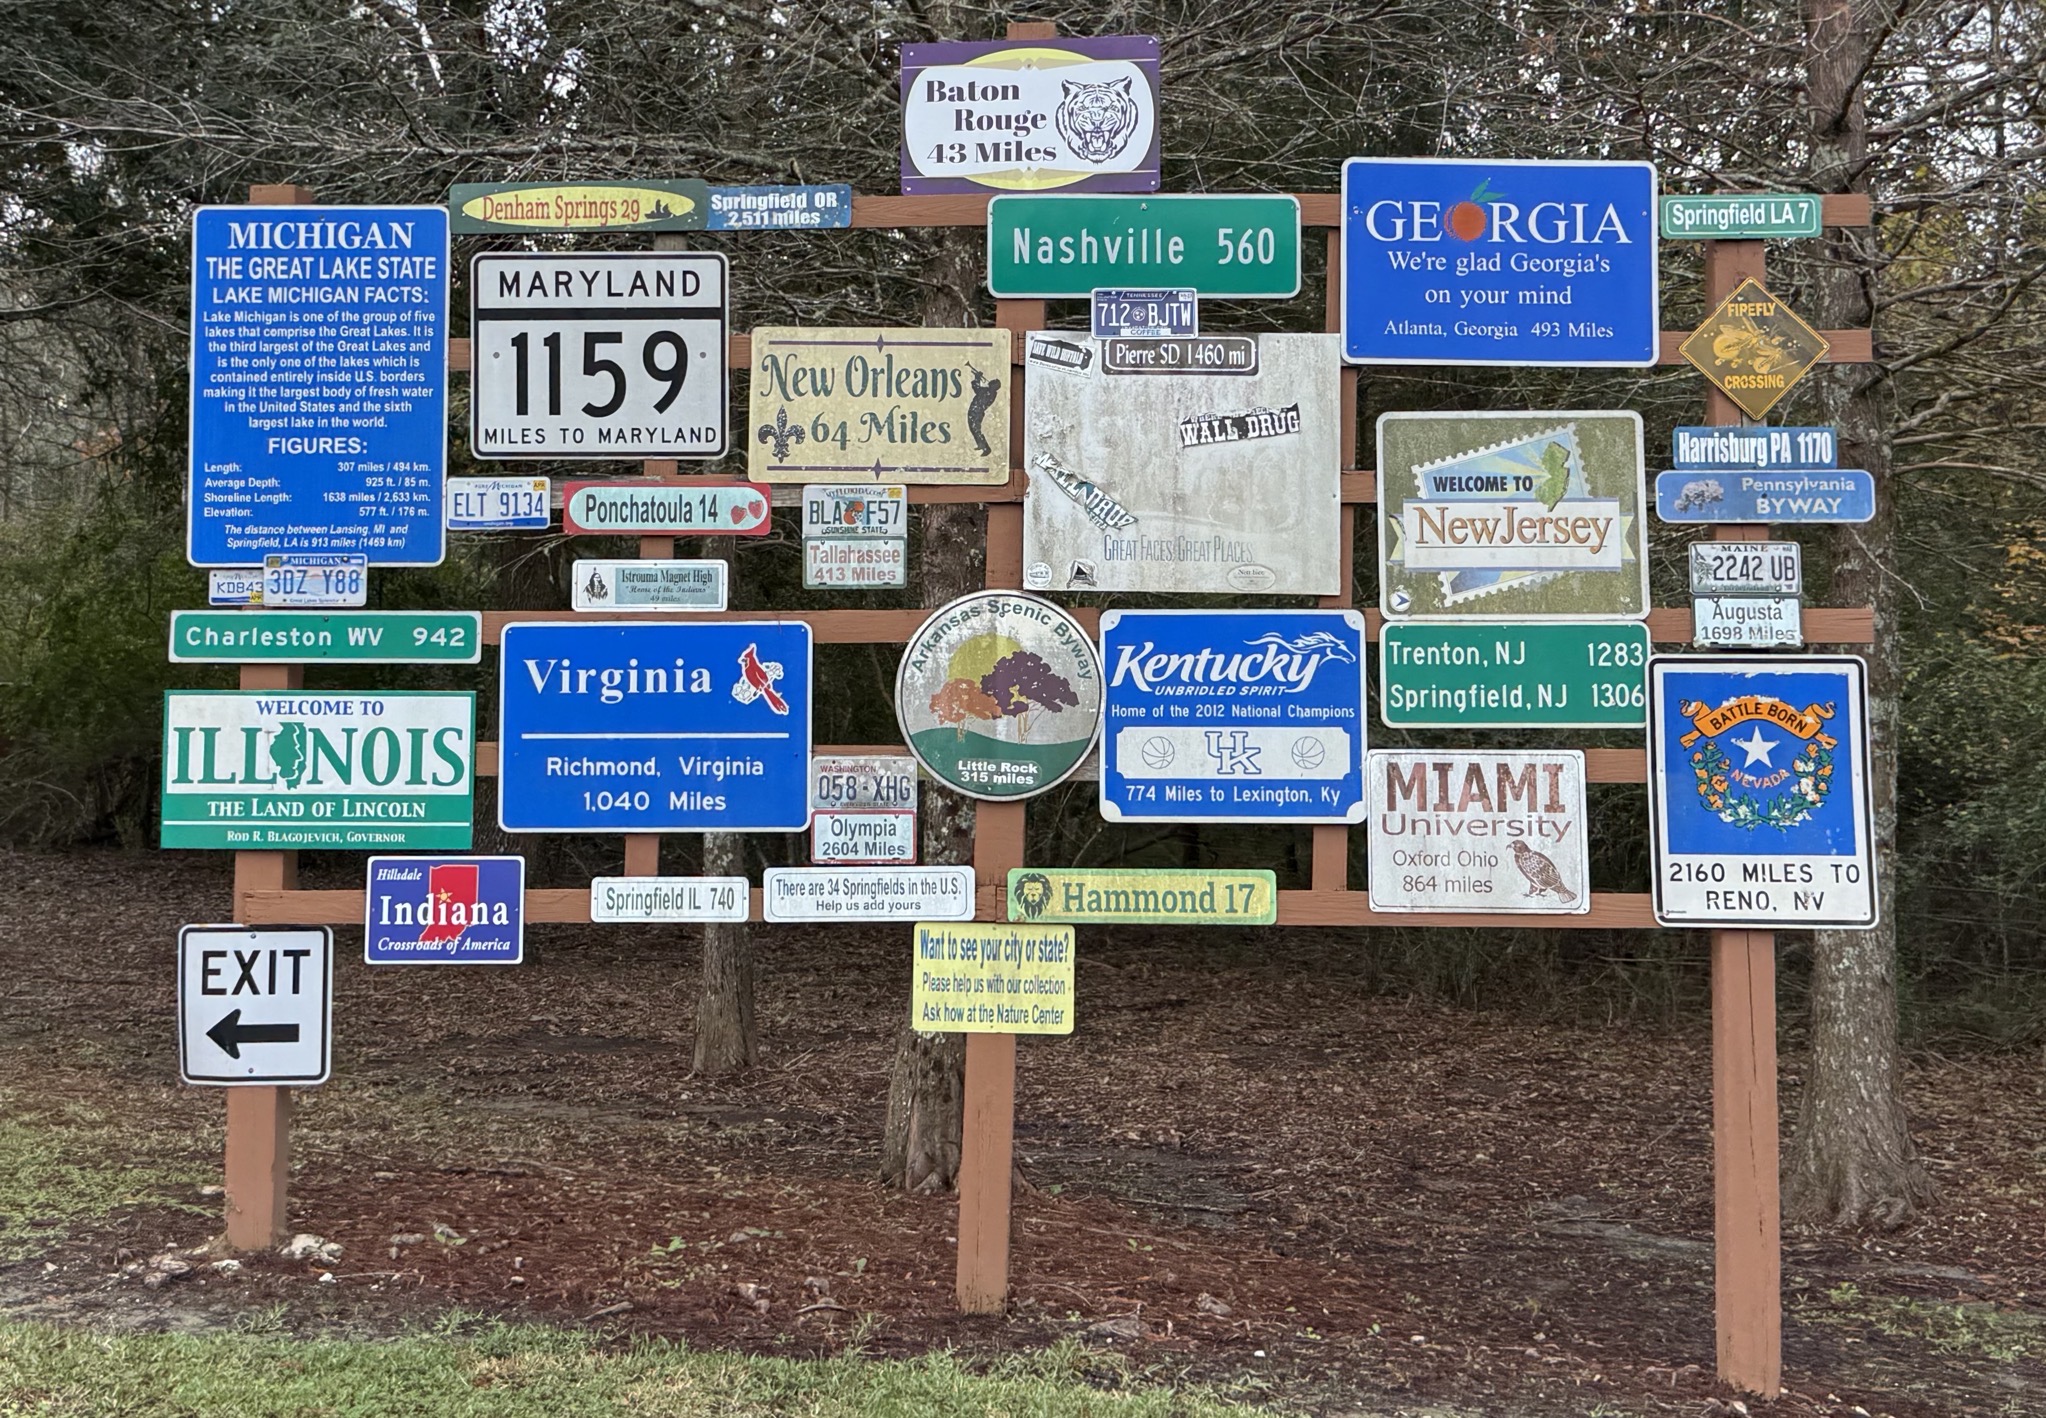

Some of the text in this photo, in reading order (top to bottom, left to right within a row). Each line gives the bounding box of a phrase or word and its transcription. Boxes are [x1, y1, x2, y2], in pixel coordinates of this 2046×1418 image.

[926, 80, 1019, 102] Baton
[955, 109, 1046, 137] Rouge
[928, 141, 1056, 163] 43 Miles
[482, 196, 640, 226] Denham Springs 29
[711, 192, 837, 211] Springfield OR
[772, 210, 820, 225] miles
[1672, 202, 1809, 229] Springfield LA 7
[228, 222, 415, 250] MICHIGAN
[1013, 228, 1275, 265] Nashville 560
[206, 257, 436, 280] THE GREAT LAKE STATE
[1387, 251, 1610, 277] We're glad Georgia's
[500, 270, 701, 298] MARYLAND
[213, 288, 430, 303] LAKE MICHIGAN FACTS:
[1425, 286, 1571, 309] on your mind
[203, 311, 435, 325] Lake Michigan is one of the group of five
[1727, 301, 1776, 317] FIREFLY
[1384, 321, 1613, 340] Atlanta, Georgia 493 Miles
[1116, 345, 1155, 365] Pierre
[1186, 345, 1224, 365] 1460
[1229, 345, 1246, 365] mi
[511, 331, 689, 418] 1159
[760, 353, 962, 402] New Orleans
[1724, 374, 1785, 389] CROSSING
[484, 428, 716, 444] MILES TO MARYLAND
[811, 405, 950, 450] 64 Miles
[267, 438, 368, 454] FIGURES:
[1678, 432, 1831, 466] Harrisburg PA 1170
[1433, 475, 1533, 492] WELCOME TO
[1742, 478, 1855, 494] Pennsylvania
[455, 492, 543, 517] ELT 9134
[586, 494, 718, 523] Ponchatoula 14
[1757, 498, 1841, 514] BYWAY
[810, 545, 900, 564] Tallahassee
[814, 567, 896, 581] 413 Miles
[1712, 604, 1782, 624] Augusta
[186, 627, 465, 647] Charleston WV 942
[1701, 627, 1795, 640] 1698 Miles
[1390, 641, 1643, 668] Trenton, NJ 1283
[1110, 641, 1320, 693] Kentucky
[523, 658, 712, 703] Virginia
[1155, 686, 1289, 696] UNBRIDLED SPIRIT
[256, 701, 384, 716] WELCOME TO
[1390, 684, 1645, 712] Springfield, NJ 1306
[547, 757, 764, 781] Richmond, Virginia
[958, 760, 1038, 774] Little Rock
[960, 771, 1034, 785] 315 miles
[1386, 762, 1567, 814] MIAMI
[669, 792, 726, 811] Miles
[1126, 786, 1341, 807] 774 Miles to Lexington, Ky
[208, 799, 426, 818] THE LAND OF LINCOLN
[831, 819, 896, 840] Olympia
[1382, 814, 1572, 843] University
[822, 842, 905, 855] 2604 Miles
[1393, 850, 1499, 868] Oxford Ohio
[377, 868, 422, 881] Hillsdale
[1669, 863, 1860, 883] 2160 MILES TO
[776, 879, 961, 900] There are 34 Springfields in the U.S.
[1402, 876, 1493, 894] 864 miles
[606, 887, 734, 916] Springfield IL 740
[1062, 882, 1256, 913] Hammond 17
[1706, 891, 1824, 912] RENO, NV
[379, 892, 509, 926] Indiana
[378, 937, 510, 954] Crossroads of America
[920, 930, 1069, 969] Want to see your city or state?
[202, 949, 311, 996] EXIT
